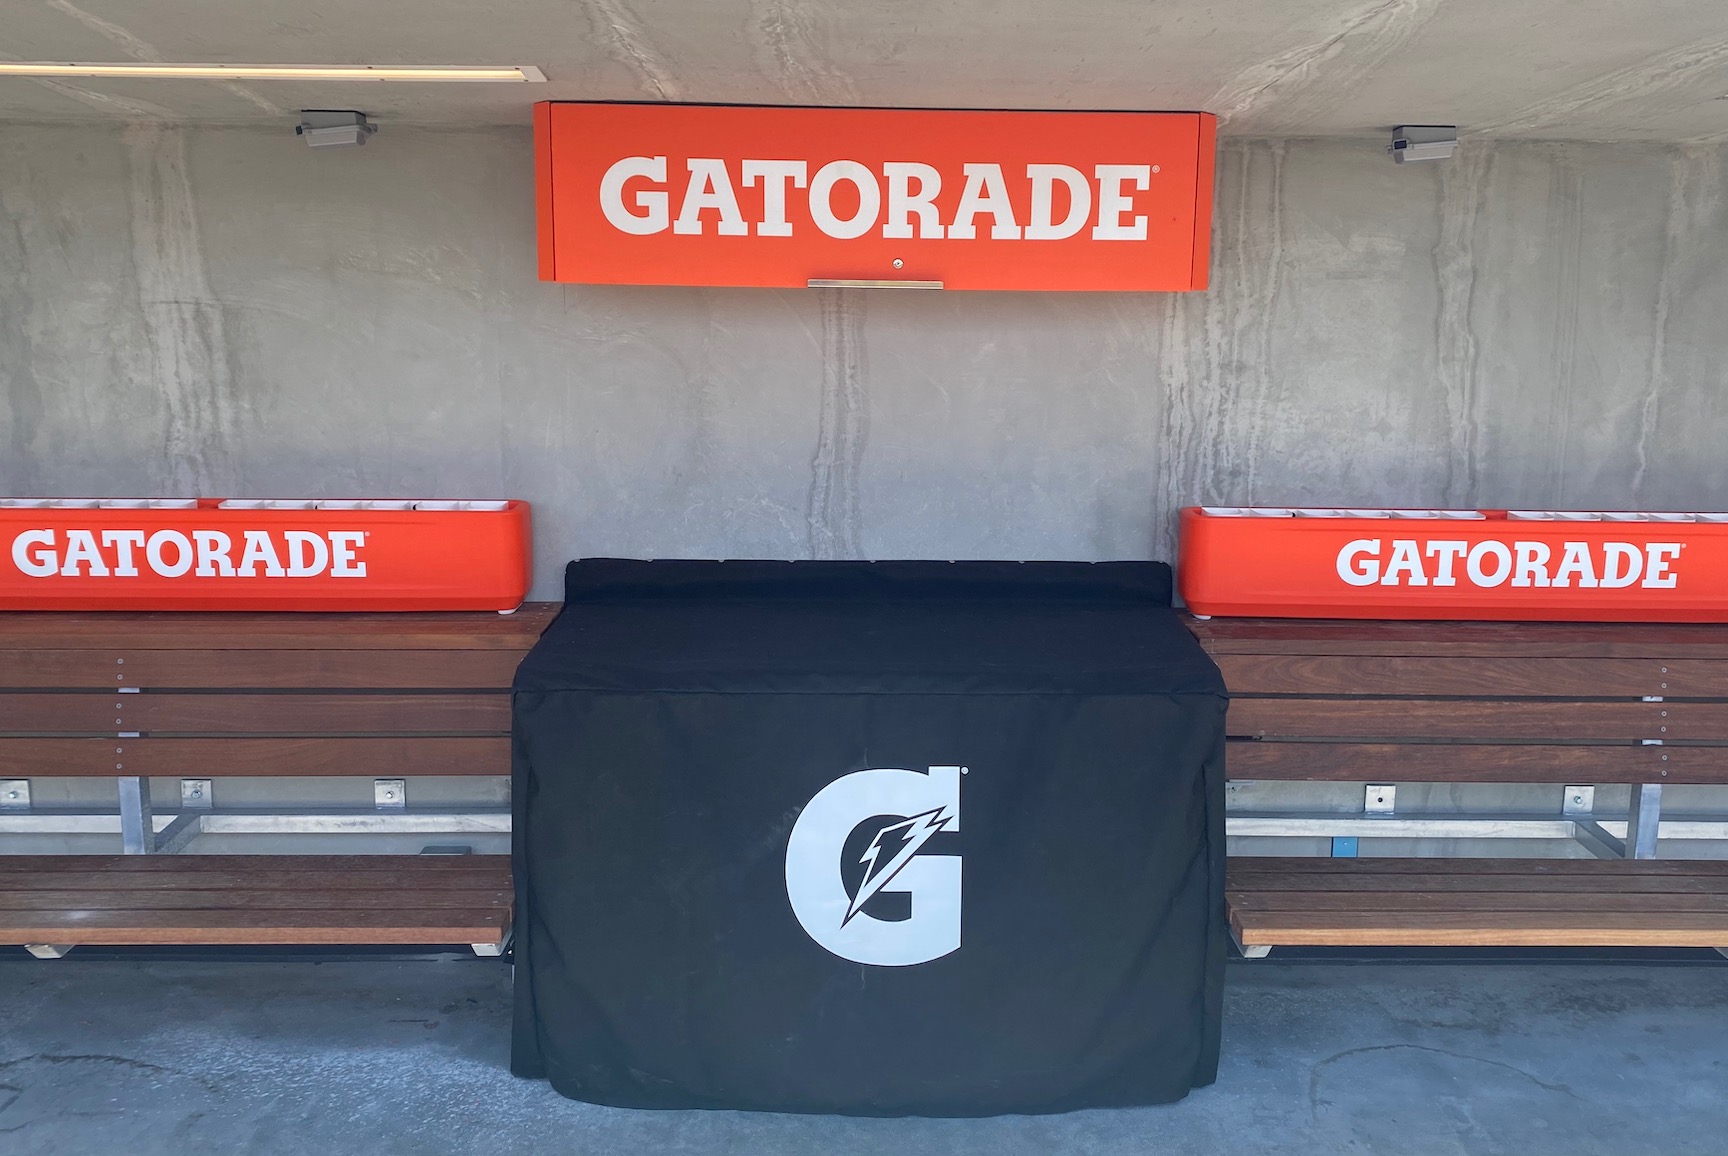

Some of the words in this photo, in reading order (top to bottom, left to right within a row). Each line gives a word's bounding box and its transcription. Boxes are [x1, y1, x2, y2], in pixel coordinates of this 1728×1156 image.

[600, 157, 1150, 240] GATORADE
[12, 529, 366, 577] GATORADE
[1337, 539, 1681, 588] GATORADE
[785, 766, 962, 966] G
